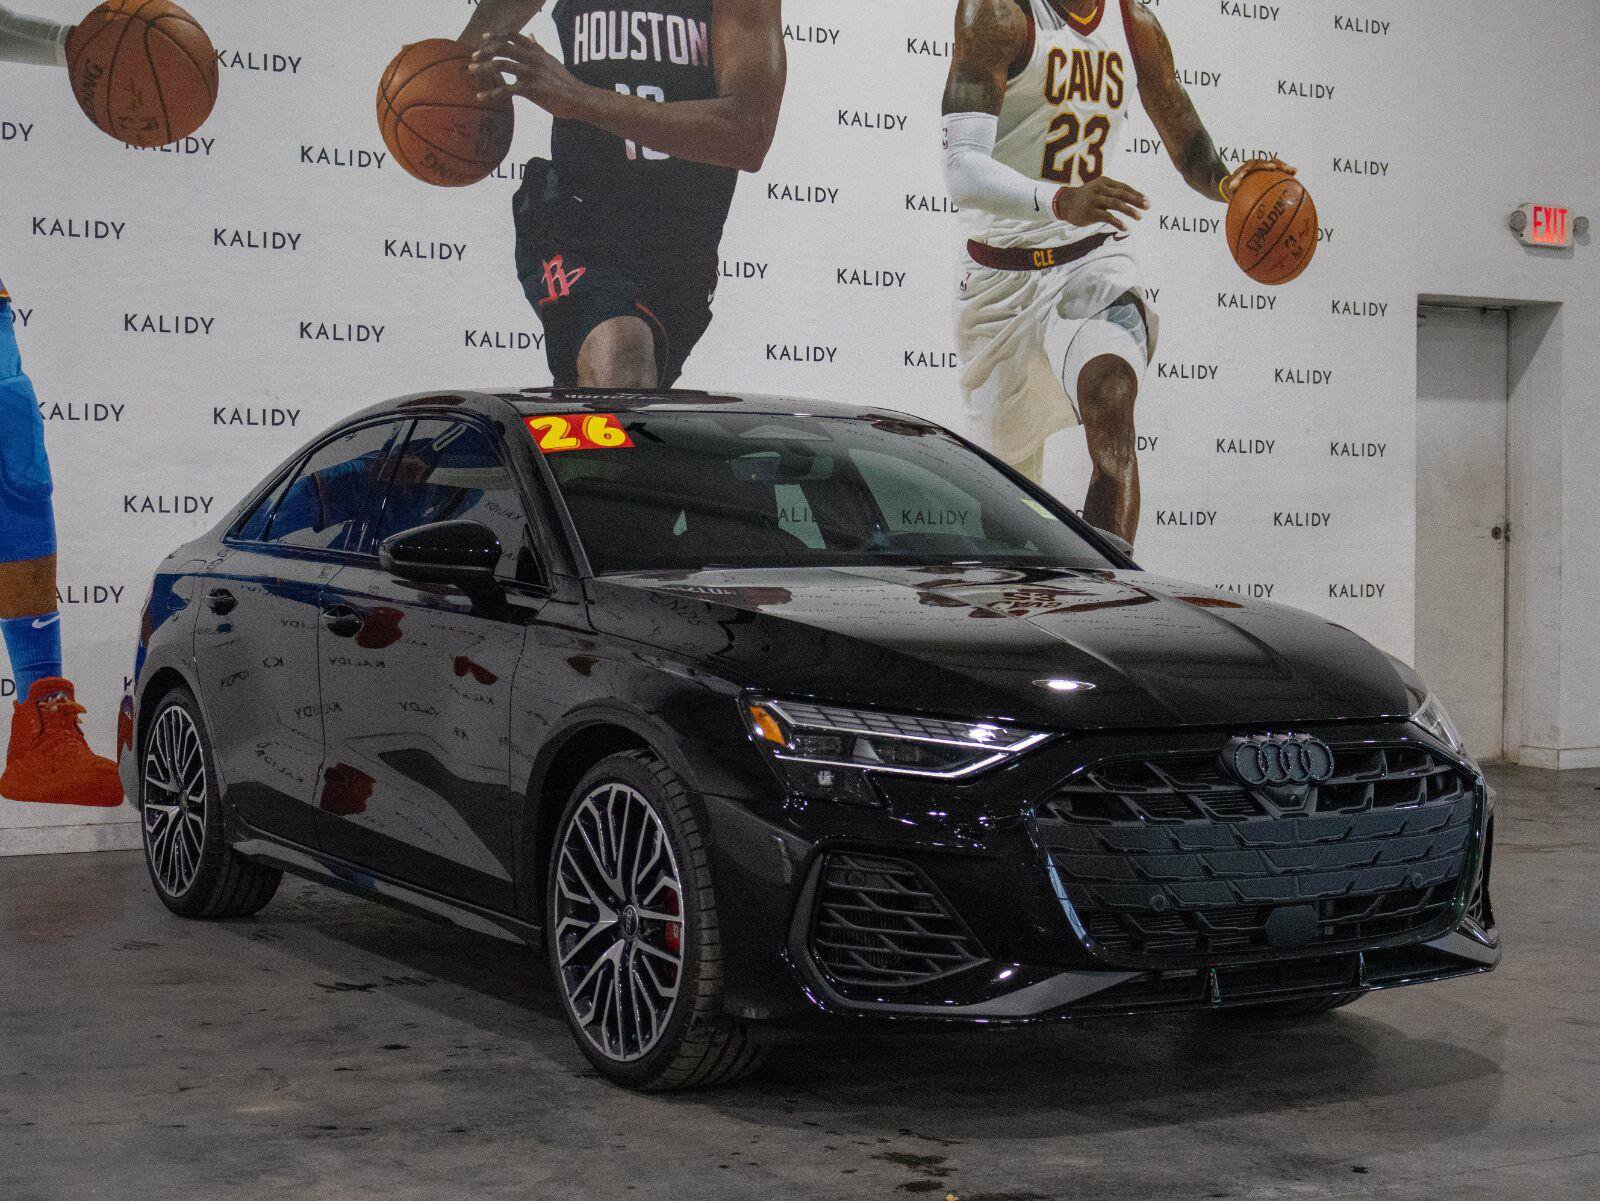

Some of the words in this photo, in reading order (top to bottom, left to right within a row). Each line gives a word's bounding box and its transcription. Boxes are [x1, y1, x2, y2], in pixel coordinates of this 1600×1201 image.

[1221, 0, 1279, 21] KALIDY
[783, 24, 839, 45] ALIDY
[1335, 16, 1390, 35] KALIDY
[574, 10, 709, 66] HOUSTON
[907, 38, 955, 58] KALI
[214, 49, 301, 73] KALIDY
[1044, 46, 1124, 110] CAVS
[1174, 69, 1221, 87] ALIDY
[1278, 80, 1334, 99] KALIDY
[839, 110, 907, 130] KALIDY
[301, 146, 386, 168] KALIDY
[1041, 112, 1111, 187] 23
[1334, 158, 1388, 176] KALIDY
[768, 183, 838, 203] KALIDY
[906, 194, 960, 213] KALI
[33, 217, 125, 239] KALIDY
[1160, 215, 1219, 233] KALIDY
[1247, 189, 1289, 256] SPALDIN
[1533, 206, 1568, 245] EXIT
[214, 229, 301, 250] KALIDY
[385, 240, 466, 260] KALIDY
[1033, 249, 1055, 267] CLE
[717, 260, 768, 279] LIDY
[838, 269, 905, 287] KALIDY
[1218, 293, 1276, 310] KALIDY
[1332, 300, 1387, 316] KALIDY
[125, 314, 214, 334] KALIDY
[300, 322, 384, 342] KALIDY
[465, 330, 545, 350] KALIDY
[767, 344, 837, 362] KALIDY
[904, 350, 957, 368] KALID
[1158, 363, 1217, 379] KALIDY
[1275, 369, 1331, 384] KALIDY
[214, 407, 300, 426] KALIDY
[530, 416, 626, 450] 26
[1217, 439, 1275, 454] KALIDY
[1331, 442, 1386, 457] KALIDY
[124, 495, 213, 513] KALIDY
[902, 509, 969, 525] KALIDY
[1157, 511, 1216, 525] KALIDY
[1274, 512, 1330, 526] KALIDY
[55, 585, 125, 604] ALIDY
[1329, 584, 1384, 597] KALIDY
